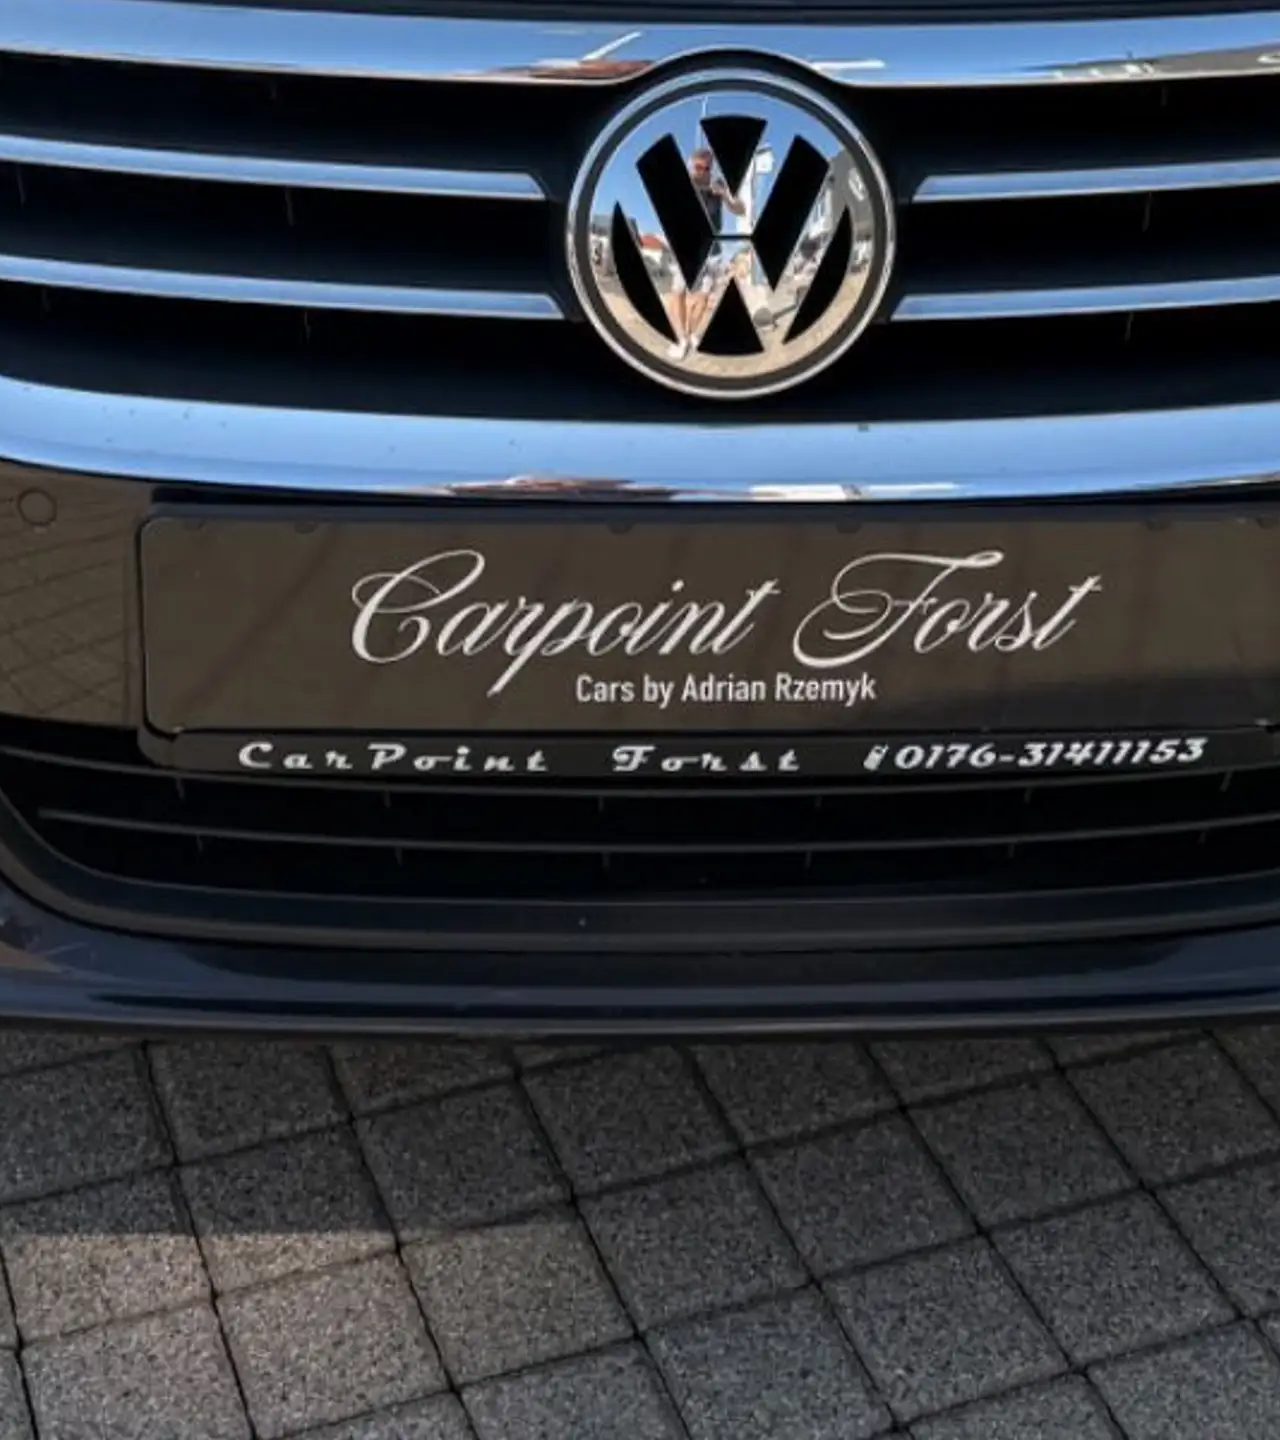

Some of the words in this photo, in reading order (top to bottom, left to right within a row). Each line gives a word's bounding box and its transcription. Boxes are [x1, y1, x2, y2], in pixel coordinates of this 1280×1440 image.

[351, 549, 781, 698] Carpoint
[792, 550, 1103, 668] Forst
[575, 673, 635, 704] Cars
[642, 673, 673, 710] by
[681, 672, 766, 704] Adrian
[774, 672, 877, 707] Rzemyk
[611, 744, 800, 773] Forst
[893, 737, 1209, 770] 0176-31411153
